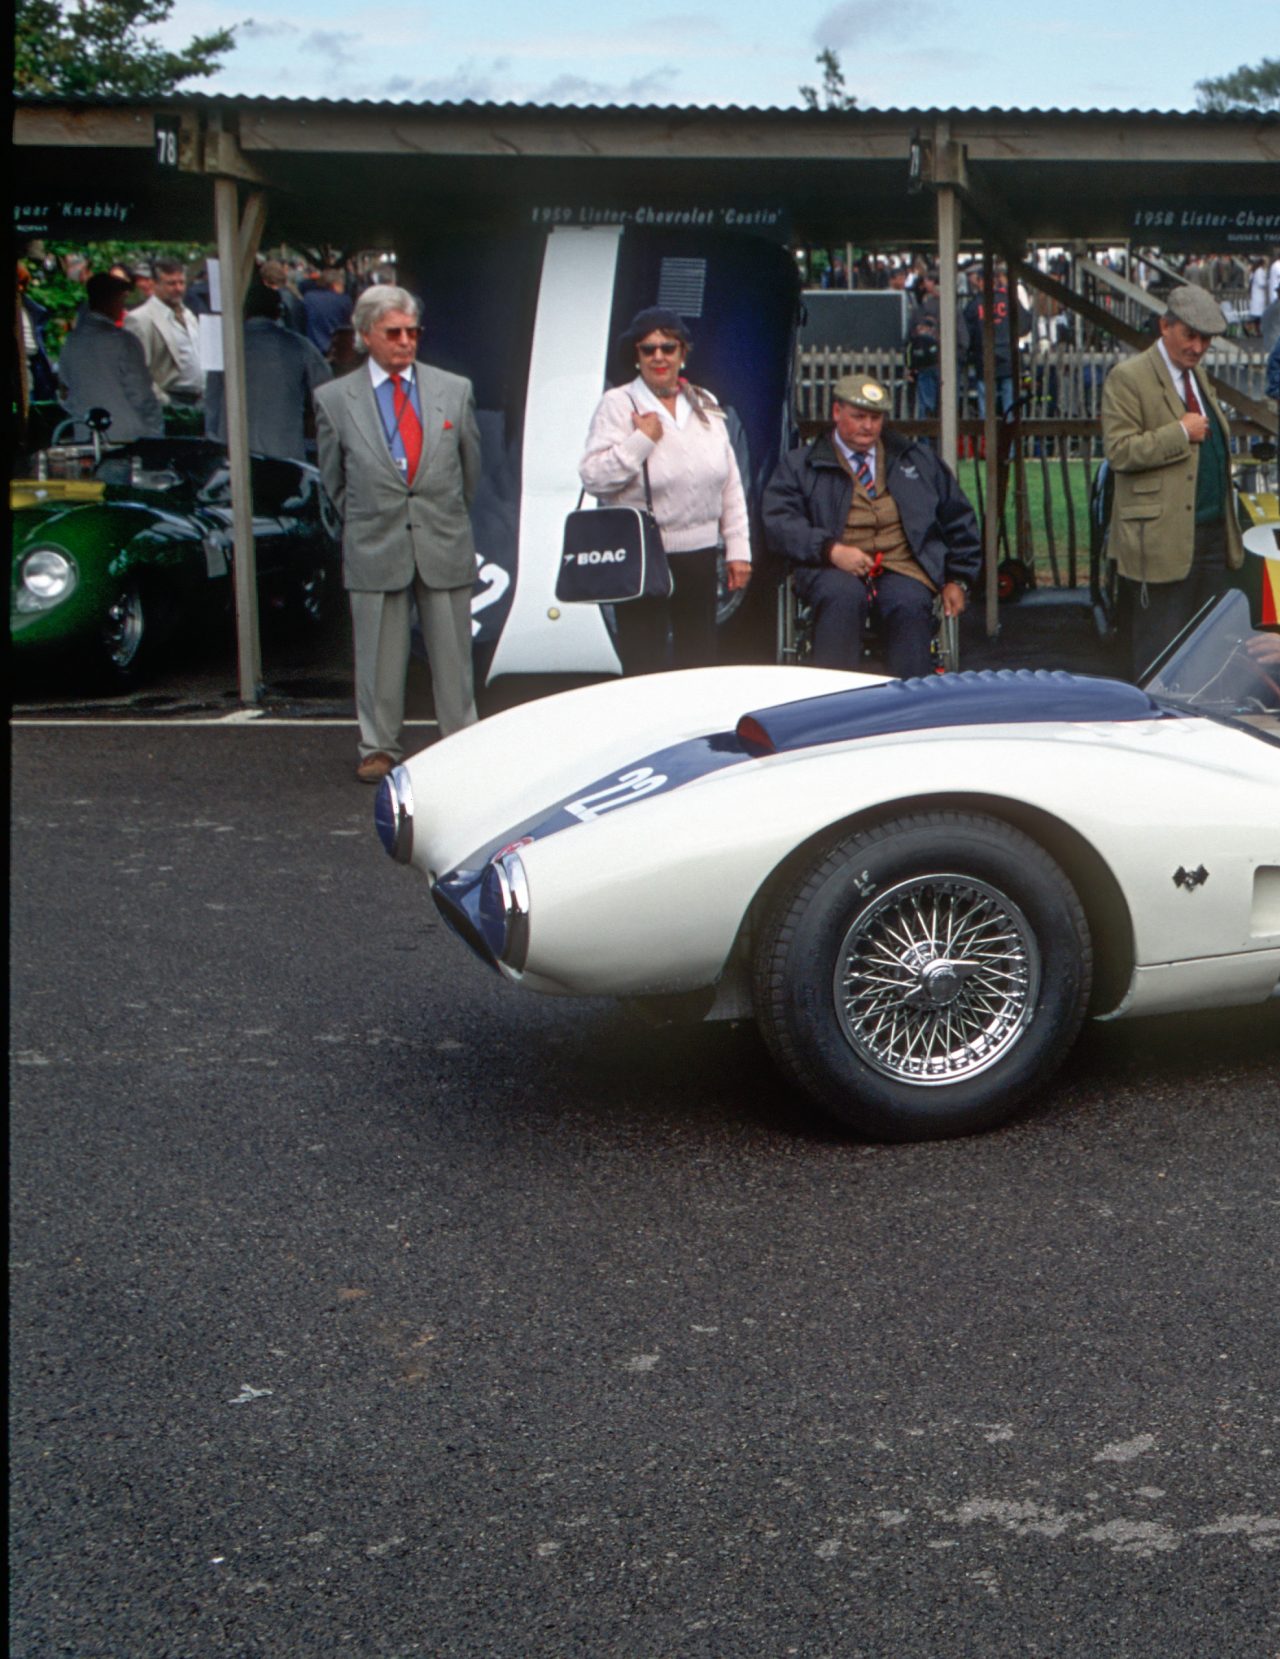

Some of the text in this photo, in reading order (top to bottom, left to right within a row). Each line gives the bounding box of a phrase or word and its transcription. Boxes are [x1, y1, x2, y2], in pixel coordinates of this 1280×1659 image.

[156, 130, 177, 165] 78
[531, 206, 573, 222] 1959
[1134, 211, 1174, 226] 1958
[577, 548, 627, 566] BOAC
[563, 766, 669, 823] 22
